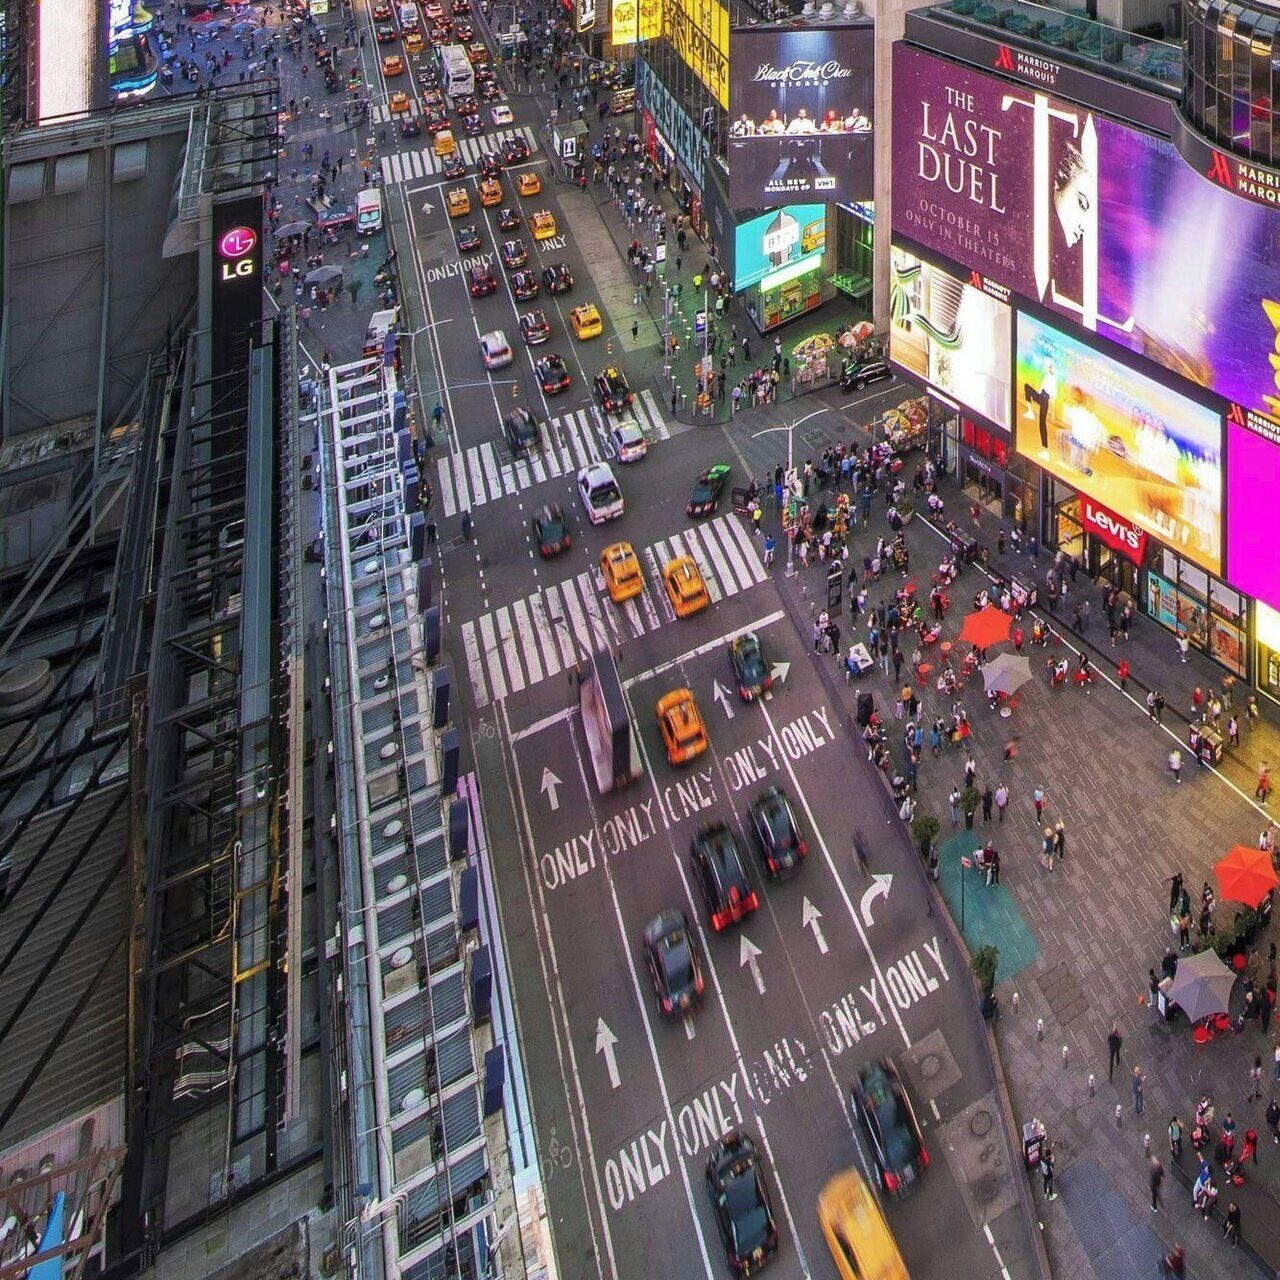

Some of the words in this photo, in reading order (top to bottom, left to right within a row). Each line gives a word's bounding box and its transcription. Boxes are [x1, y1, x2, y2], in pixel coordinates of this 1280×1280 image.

[753, 63, 790, 82] Black
[788, 61, 821, 81] Ink
[1017, 53, 1060, 75] MARRIOTT
[1017, 64, 1055, 84] MARQUIS
[771, 80, 829, 88] CHICAGO
[945, 87, 974, 112] THE
[922, 101, 1001, 166] LAST
[917, 142, 1006, 214] DUEL
[920, 199, 981, 238] OCTOBER
[906, 209, 935, 230] ONLY
[939, 225, 951, 239] IN
[957, 233, 1015, 271] THEATERS
[223, 259, 253, 280] LG
[427, 262, 461, 283] ONLY
[540, 828, 596, 890] ONLY
[603, 798, 657, 855] ONLY
[723, 735, 780, 791] ONLY
[781, 706, 836, 760] ONLY
[604, 1120, 671, 1211] ONLY
[678, 1073, 743, 1157] ONLY
[818, 978, 887, 1056] ONLY
[886, 936, 950, 1010] ONLY
